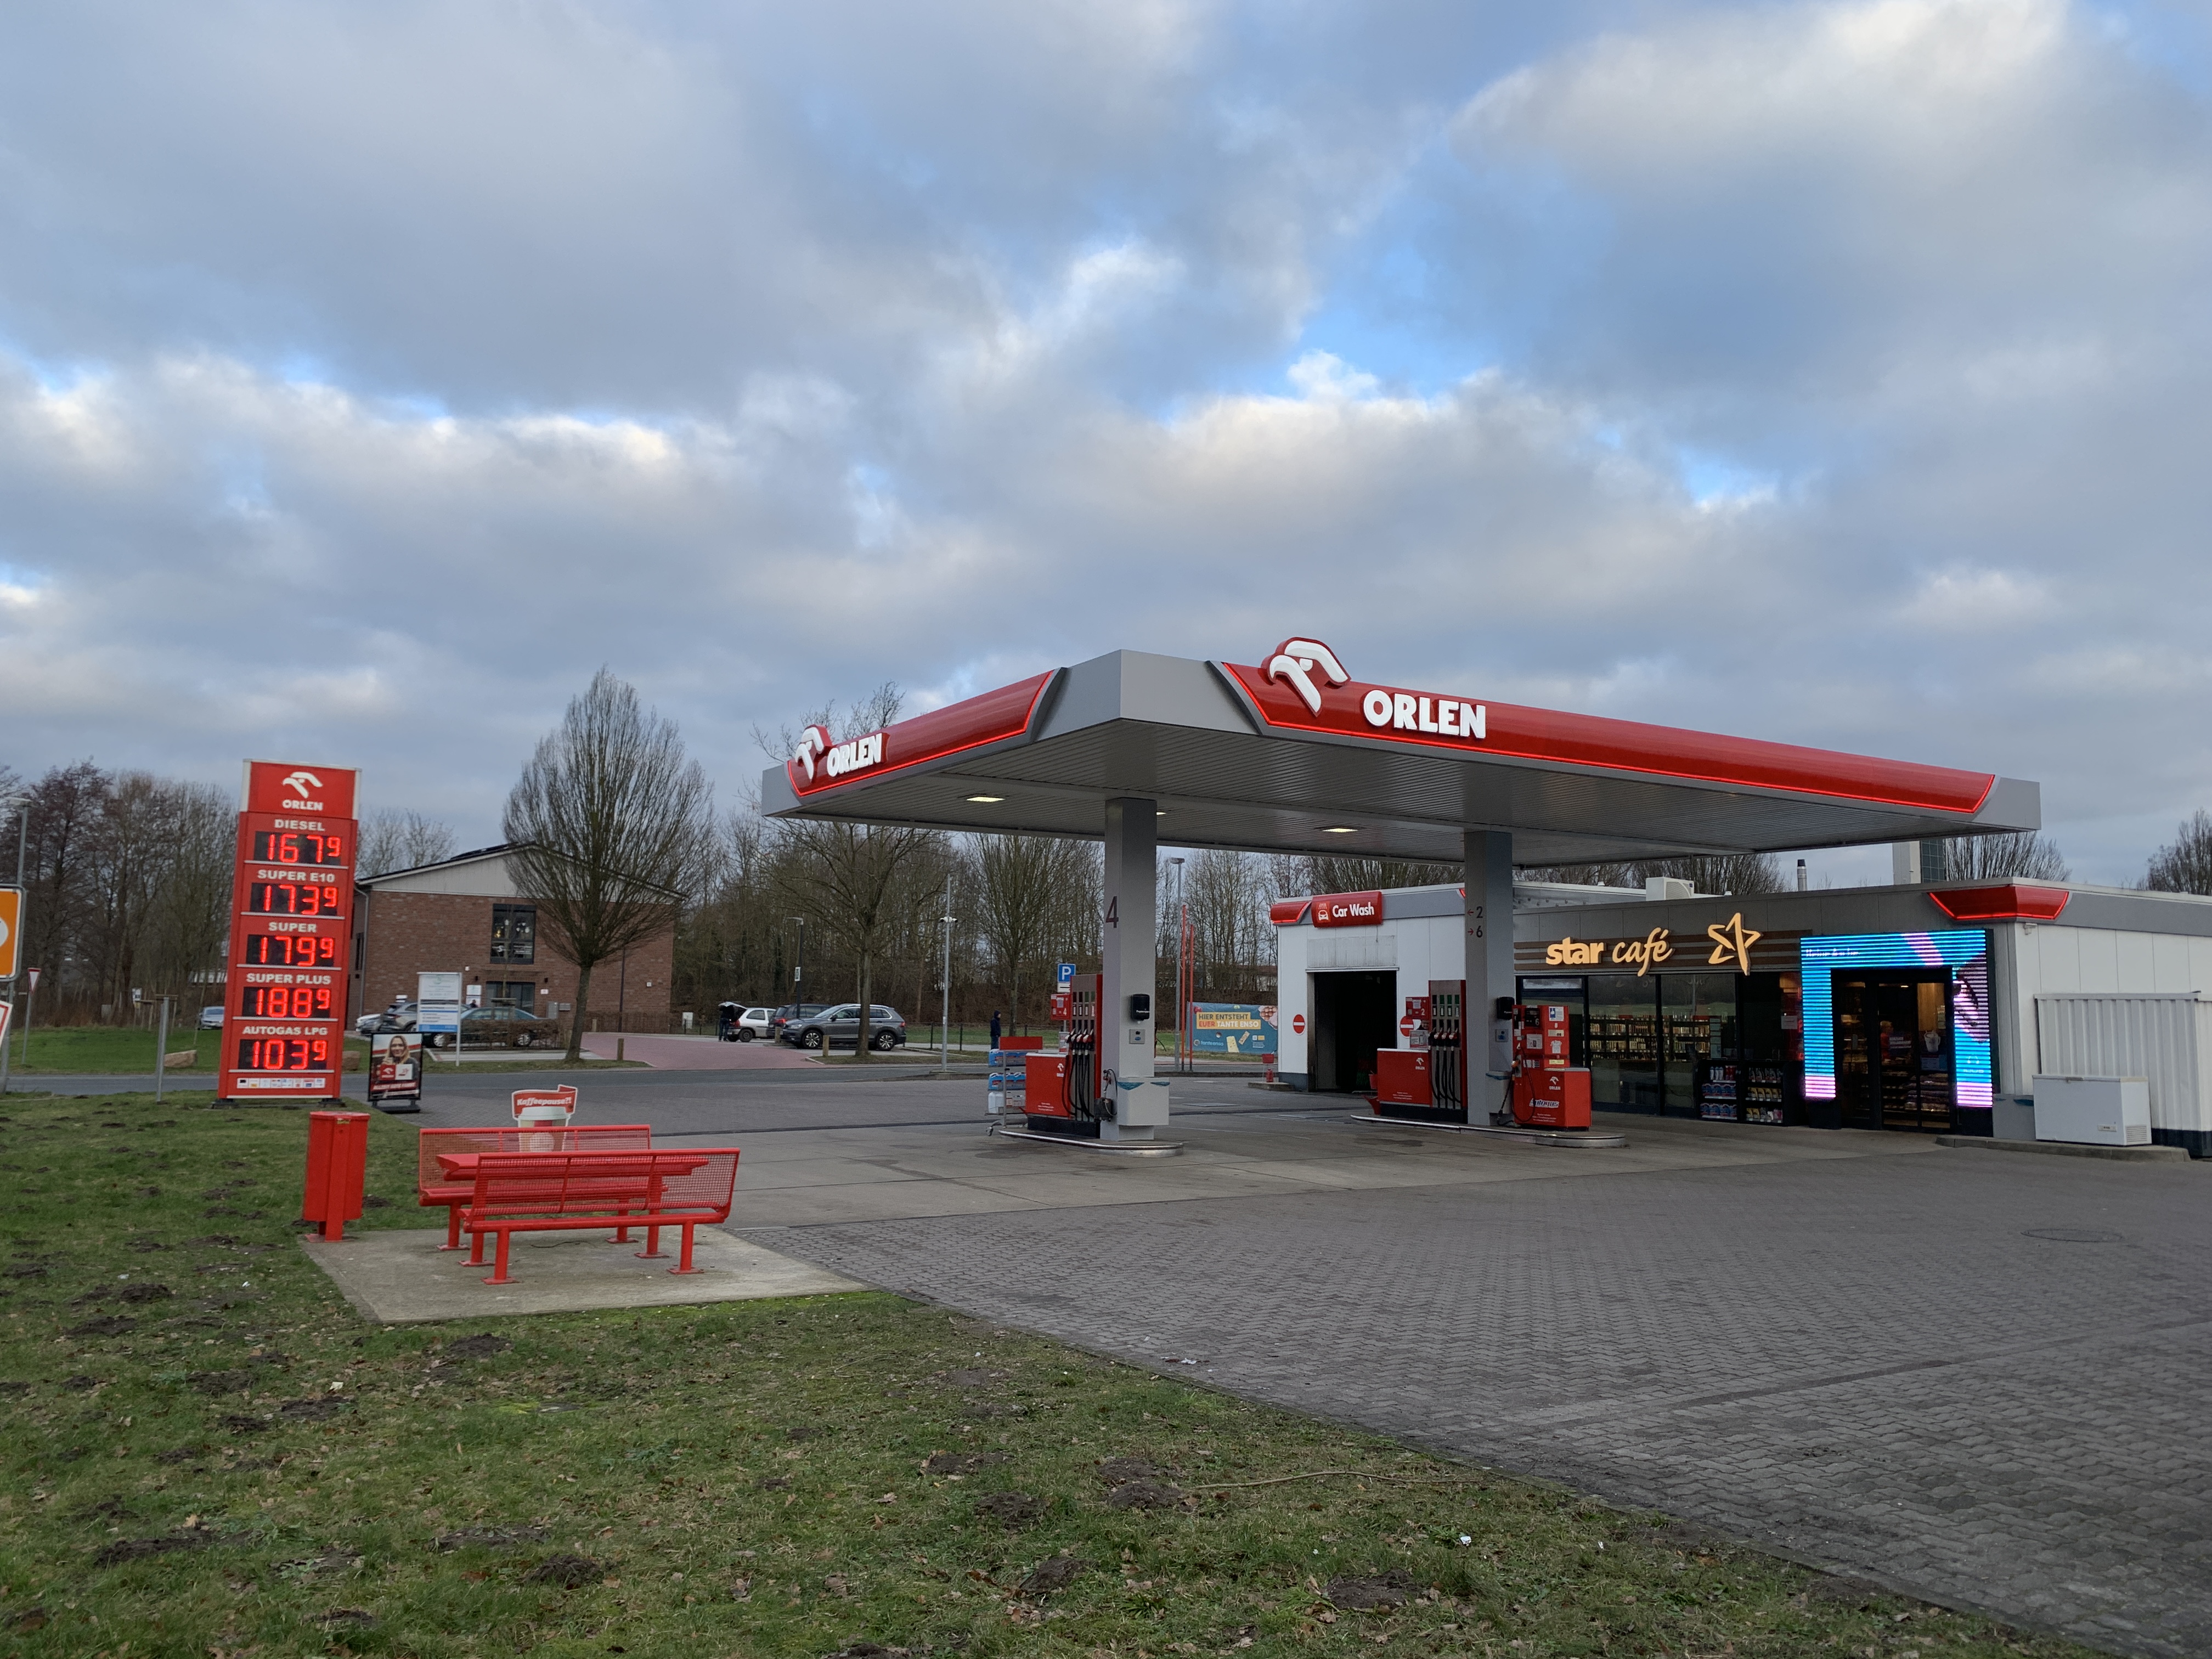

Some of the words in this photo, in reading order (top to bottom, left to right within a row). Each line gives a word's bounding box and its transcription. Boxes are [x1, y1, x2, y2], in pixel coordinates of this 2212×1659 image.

[1363, 689, 1486, 739] ORLEN
[827, 733, 882, 777] ORLEN
[283, 799, 323, 811] ORLEN
[274, 819, 325, 831] DIESEL
[257, 870, 306, 881] SUPER
[310, 873, 335, 882] E10
[1105, 896, 1119, 928] 4
[1332, 905, 1347, 918] Car
[1350, 902, 1374, 917] Wash
[1476, 906, 1483, 918] 2
[268, 922, 317, 933] SUPER
[1476, 926, 1483, 938] 6
[1545, 936, 1605, 965] star
[1612, 927, 1673, 977] café
[246, 973, 293, 984] SUPER
[296, 974, 331, 985] PLUS
[1062, 966, 1071, 980] P
[242, 1026, 301, 1035] AUTOGAS
[304, 1027, 328, 1035] LPG
[517, 1097, 572, 1106] Kaffeepause?!
